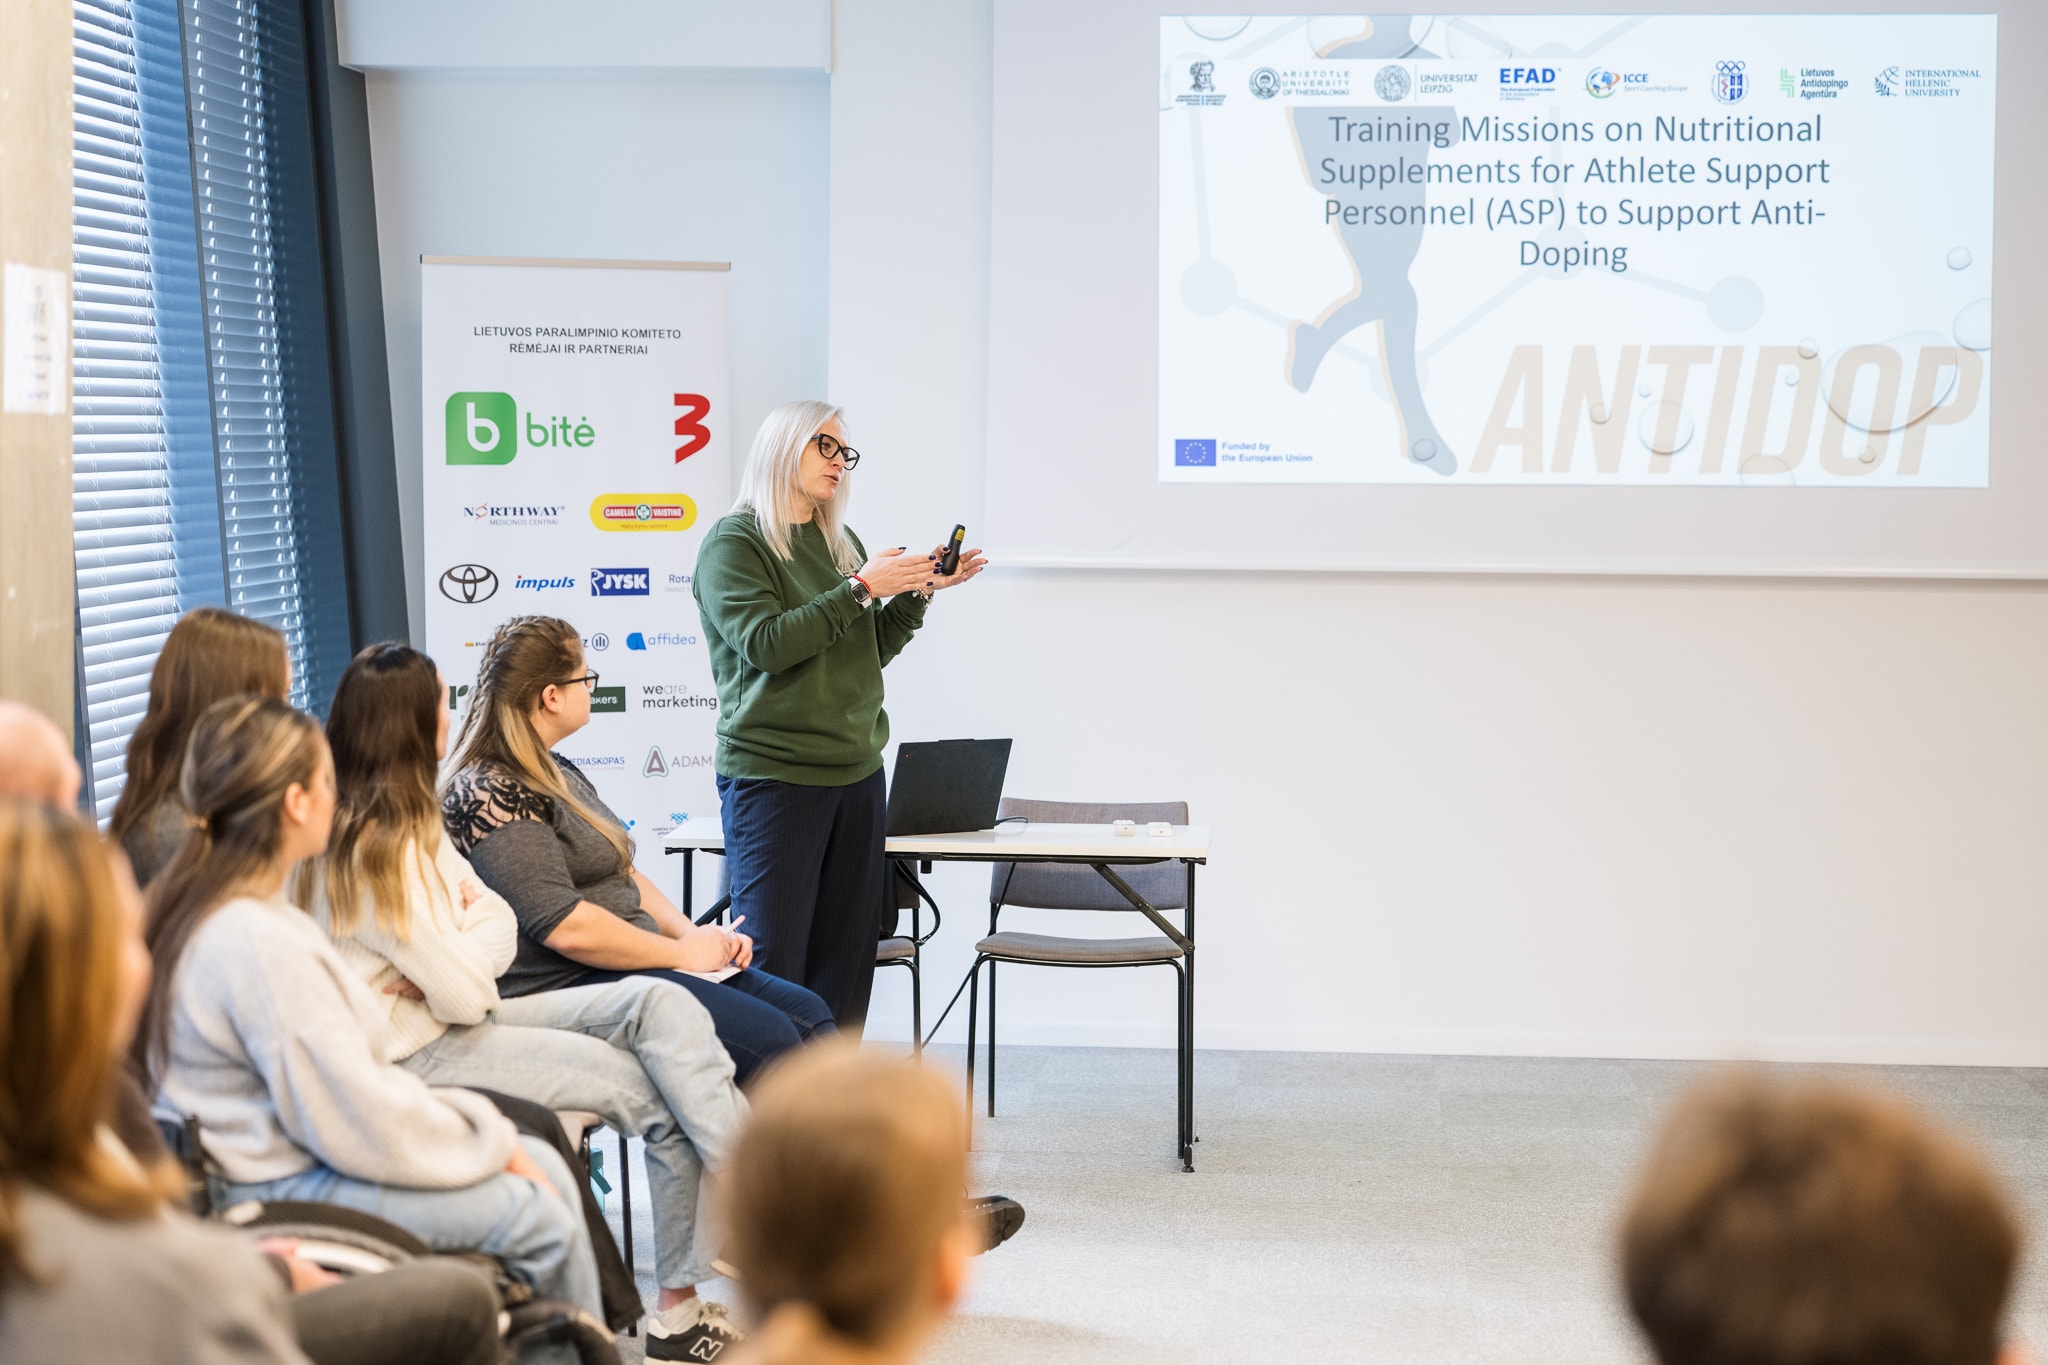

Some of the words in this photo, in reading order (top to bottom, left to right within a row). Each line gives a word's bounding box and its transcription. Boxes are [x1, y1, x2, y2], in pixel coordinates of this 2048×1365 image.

[1283, 70, 1350, 78] ARISTOTLE
[1500, 68, 1556, 83] EFAD
[1624, 73, 1649, 83] ICCE
[1800, 68, 1835, 77] Lietuvos
[1905, 69, 1981, 78] INTERNATIONAL
[1420, 84, 1453, 94] LEIPZIG
[1800, 79, 1849, 90] Antidopingo
[1905, 79, 1951, 87] HELLENIC
[1905, 88, 1961, 97] UNIVERSITY
[1329, 115, 1450, 147] Training
[1462, 115, 1594, 142] Missions
[1605, 121, 1642, 142] on
[1654, 114, 1822, 142] Nutritional
[1320, 157, 1520, 191] Supplements
[1530, 157, 1574, 183] for
[1584, 157, 1696, 183] Athlete
[1707, 158, 1830, 191] Support
[1325, 197, 1475, 225] Personnel
[1487, 197, 1566, 231] (ASP)
[1577, 203, 1608, 225] to
[1618, 199, 1741, 231] Support
[1751, 198, 1826, 225] Anti-
[1520, 240, 1628, 272] Doping
[474, 326, 532, 337] LIETUVOS
[536, 327, 618, 338] PARALIMPINIO
[622, 329, 681, 339] KOMITETO
[509, 341, 561, 354] RĖMĖJAI
[564, 344, 575, 354] IR
[579, 344, 648, 355] PARTNERIAI
[1468, 345, 1984, 477] ANTIDOP
[526, 412, 595, 447] bitė
[1222, 442, 1256, 450] Funded
[1259, 442, 1270, 452] by
[1239, 454, 1283, 463] European
[606, 508, 634, 517] CAMELIA
[515, 575, 575, 591] impuls
[602, 574, 648, 589] JYSK
[669, 574, 692, 583] Rota
[648, 634, 696, 646] affidea
[589, 696, 618, 704] akers
[643, 695, 717, 710] marketing
[671, 755, 712, 768] ADAM
[689, 1336, 724, 1361] N
